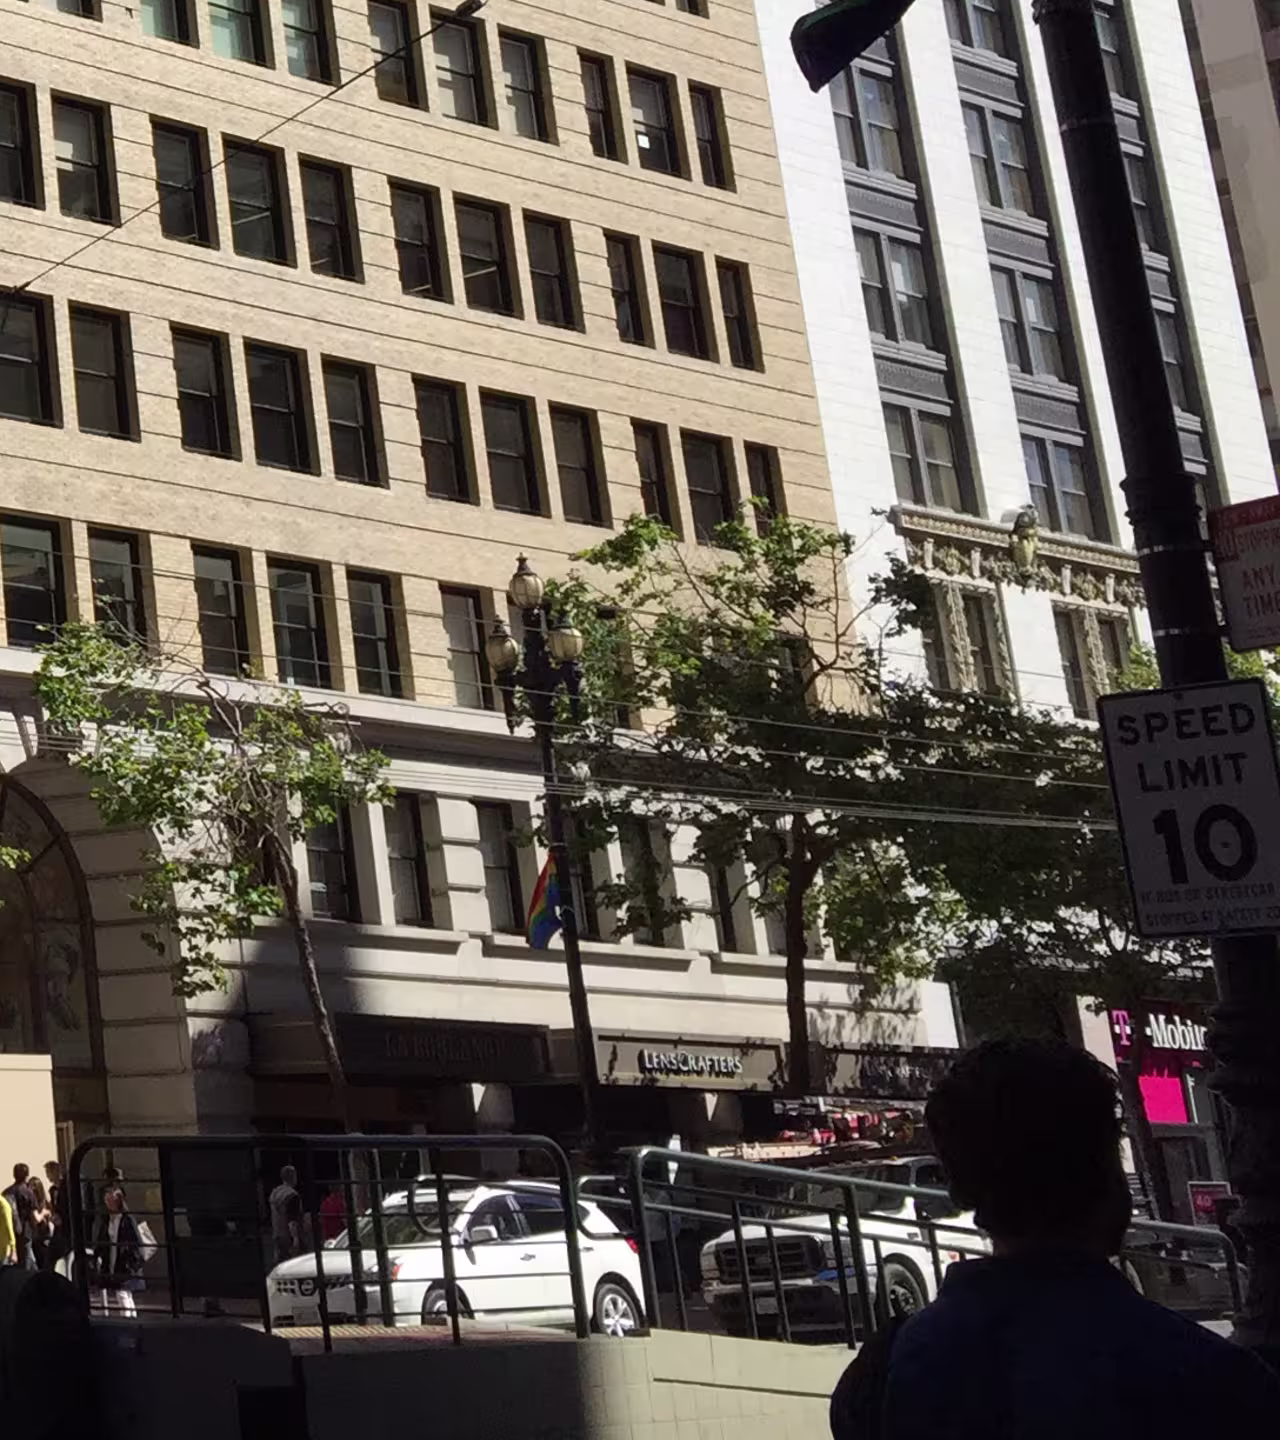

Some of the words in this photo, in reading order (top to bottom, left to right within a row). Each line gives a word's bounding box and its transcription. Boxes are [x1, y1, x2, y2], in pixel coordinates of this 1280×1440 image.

[1243, 564, 1275, 592] ANY
[1117, 702, 1255, 746] SPEED
[1138, 752, 1247, 792] LIMIT
[1153, 804, 1258, 884] 10
[643, 1049, 743, 1073] LENSCRAFTERS
